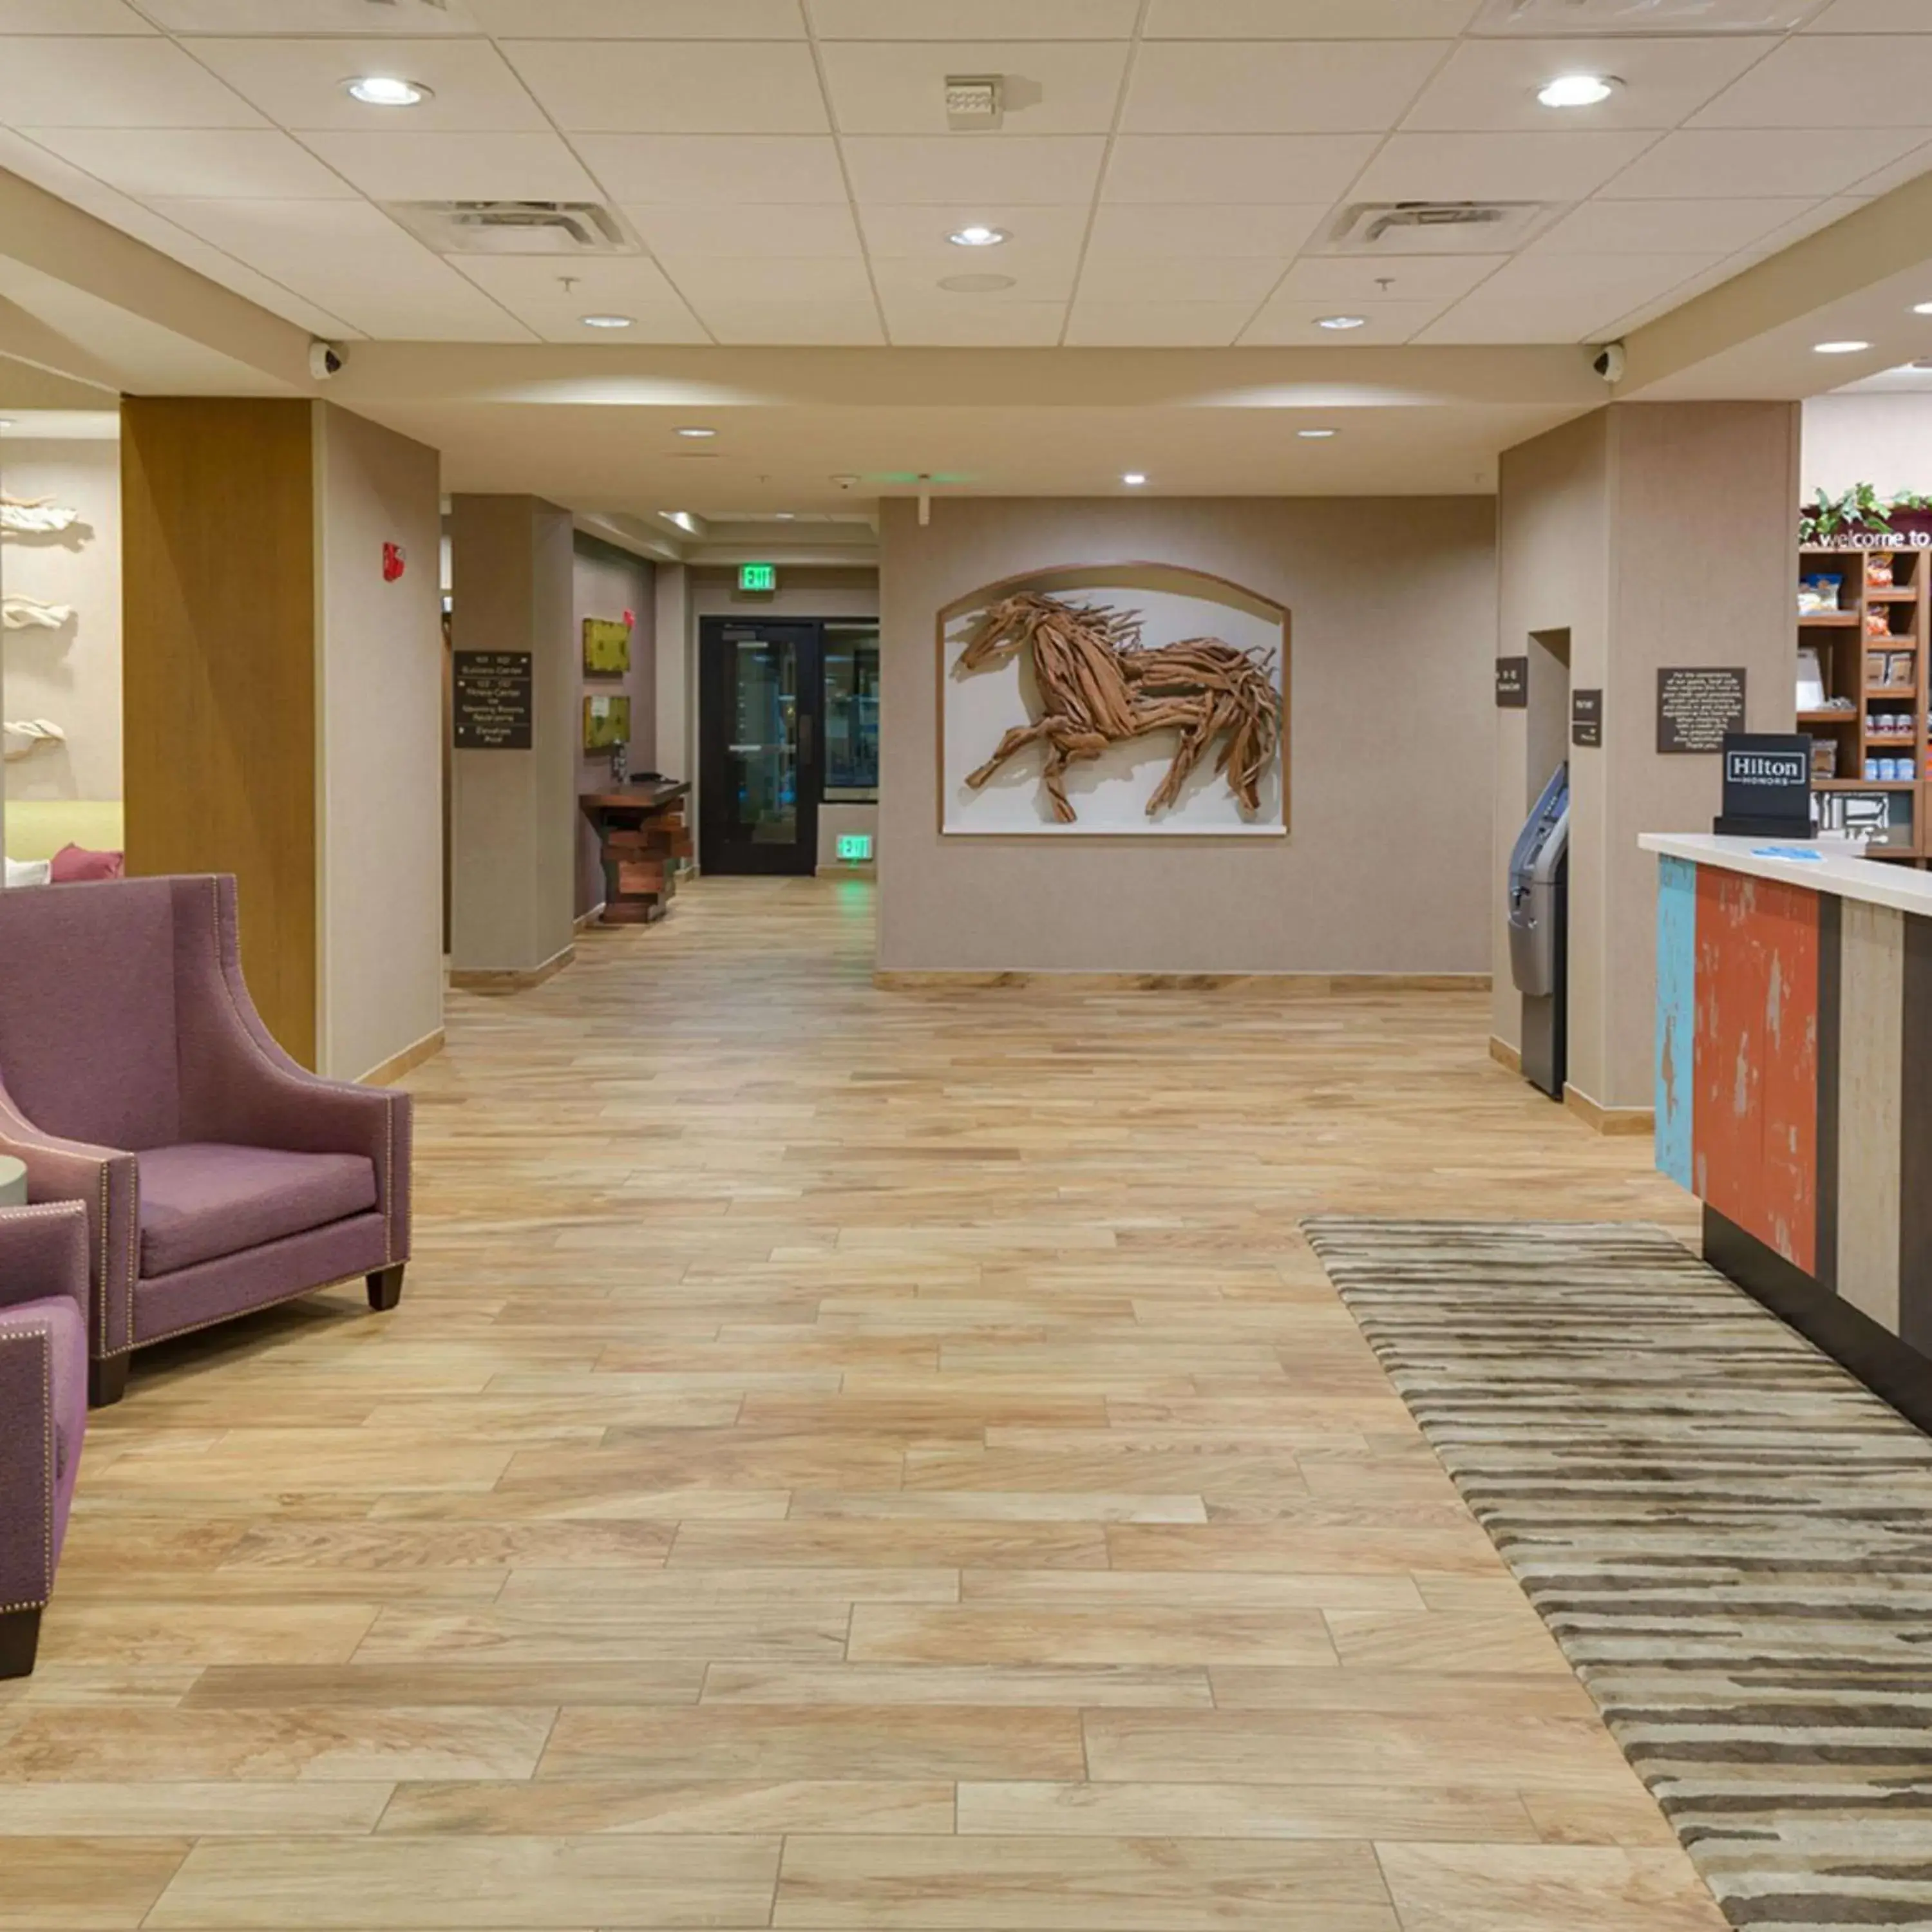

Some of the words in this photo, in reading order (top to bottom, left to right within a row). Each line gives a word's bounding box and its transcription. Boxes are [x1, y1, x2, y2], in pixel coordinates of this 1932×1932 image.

[1819, 529, 1905, 547] welcome
[1909, 529, 1930, 547] to
[1734, 758, 1799, 776] Hilton
